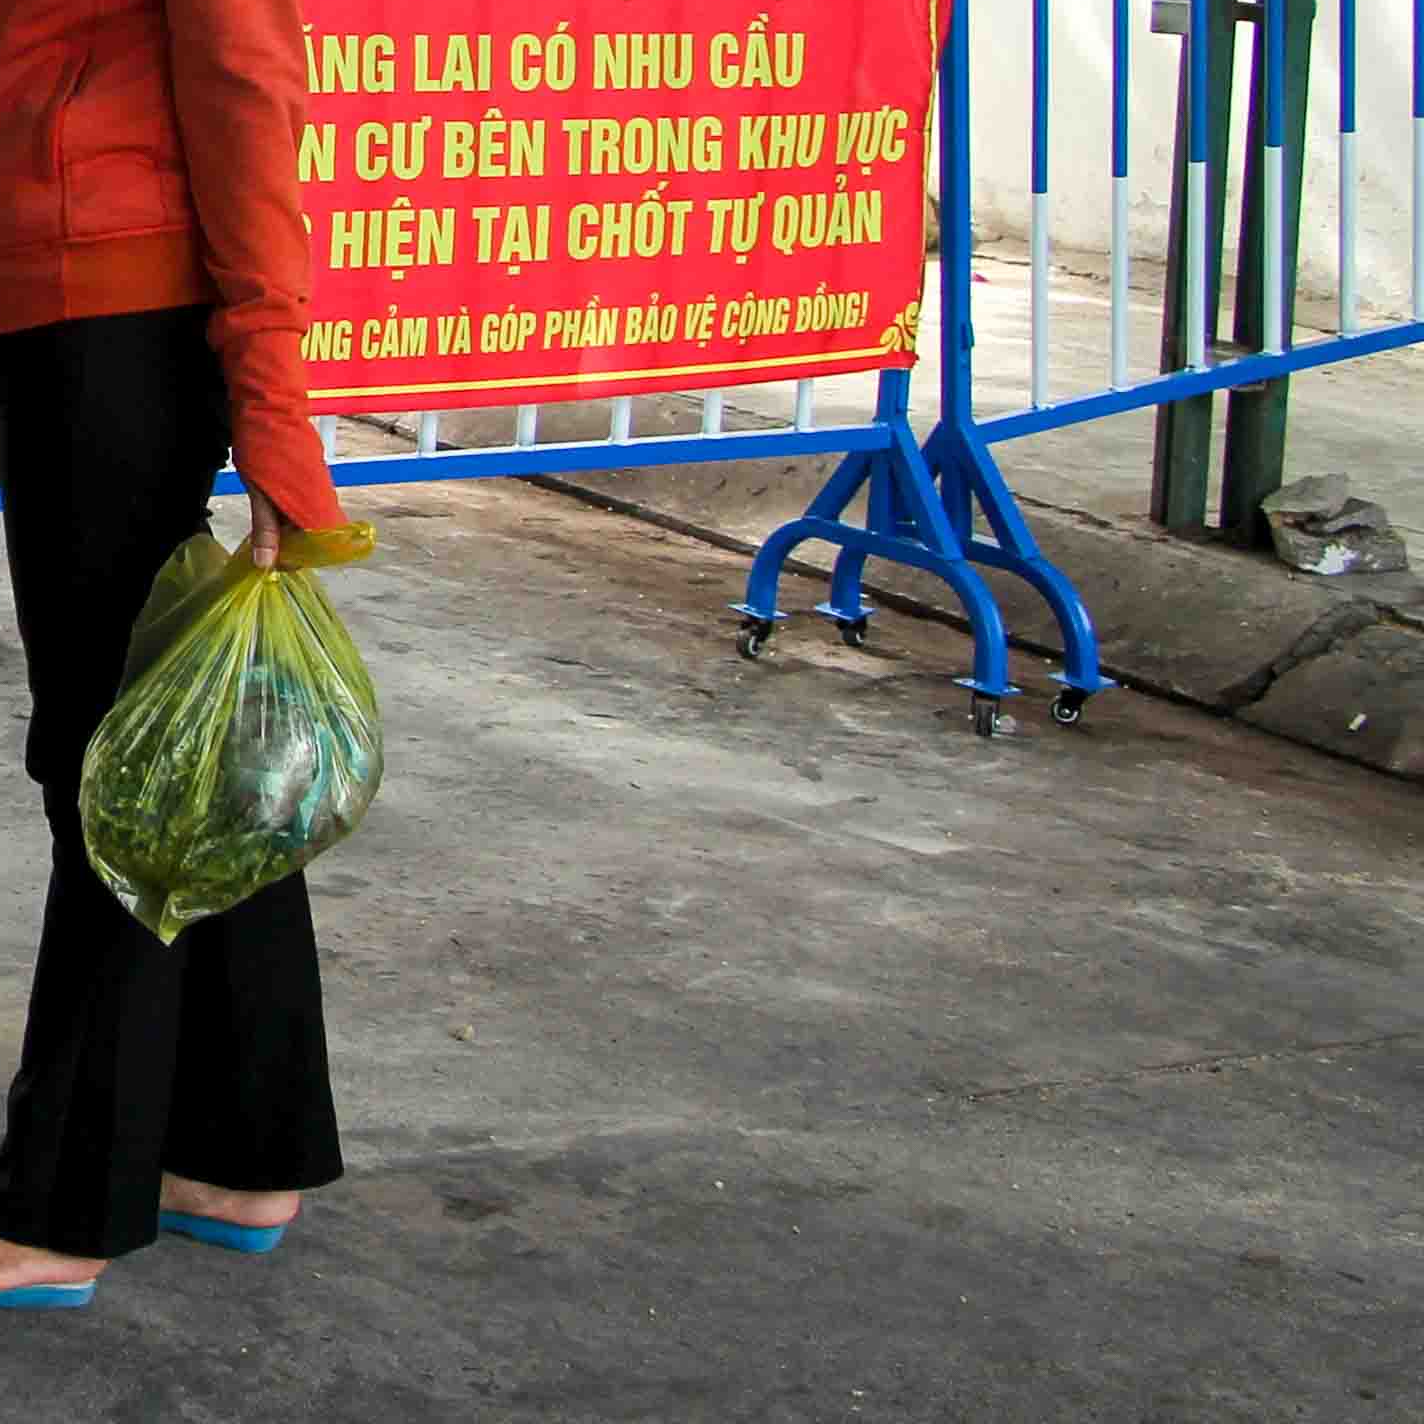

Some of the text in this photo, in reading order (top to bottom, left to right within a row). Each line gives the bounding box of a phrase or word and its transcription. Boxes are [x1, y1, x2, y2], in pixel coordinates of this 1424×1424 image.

[414, 34, 492, 92] LAI
[510, 21, 577, 92] CÓ
[592, 33, 694, 90] NHU
[709, 13, 805, 89] CẦU
[355, 115, 433, 182] CƯ
[442, 107, 546, 179] BÊN
[561, 115, 723, 176] TRONG
[738, 113, 826, 171] KHU
[835, 105, 909, 179] VỰC
[329, 196, 456, 281] HIỆN
[472, 205, 550, 276] TẠI
[567, 180, 694, 260] CHỐT
[706, 191, 765, 265] TỰ
[772, 173, 883, 256] QUẢN
[360, 304, 429, 360] CẢM
[437, 306, 472, 356] VÀ
[480, 303, 537, 353] GÓP
[543, 295, 620, 350] PHẦN
[623, 292, 679, 345] BẢO
[684, 294, 718, 348] VỆ
[721, 291, 791, 345] CỘNG
[794, 282, 869, 333] ĐỒNG!
